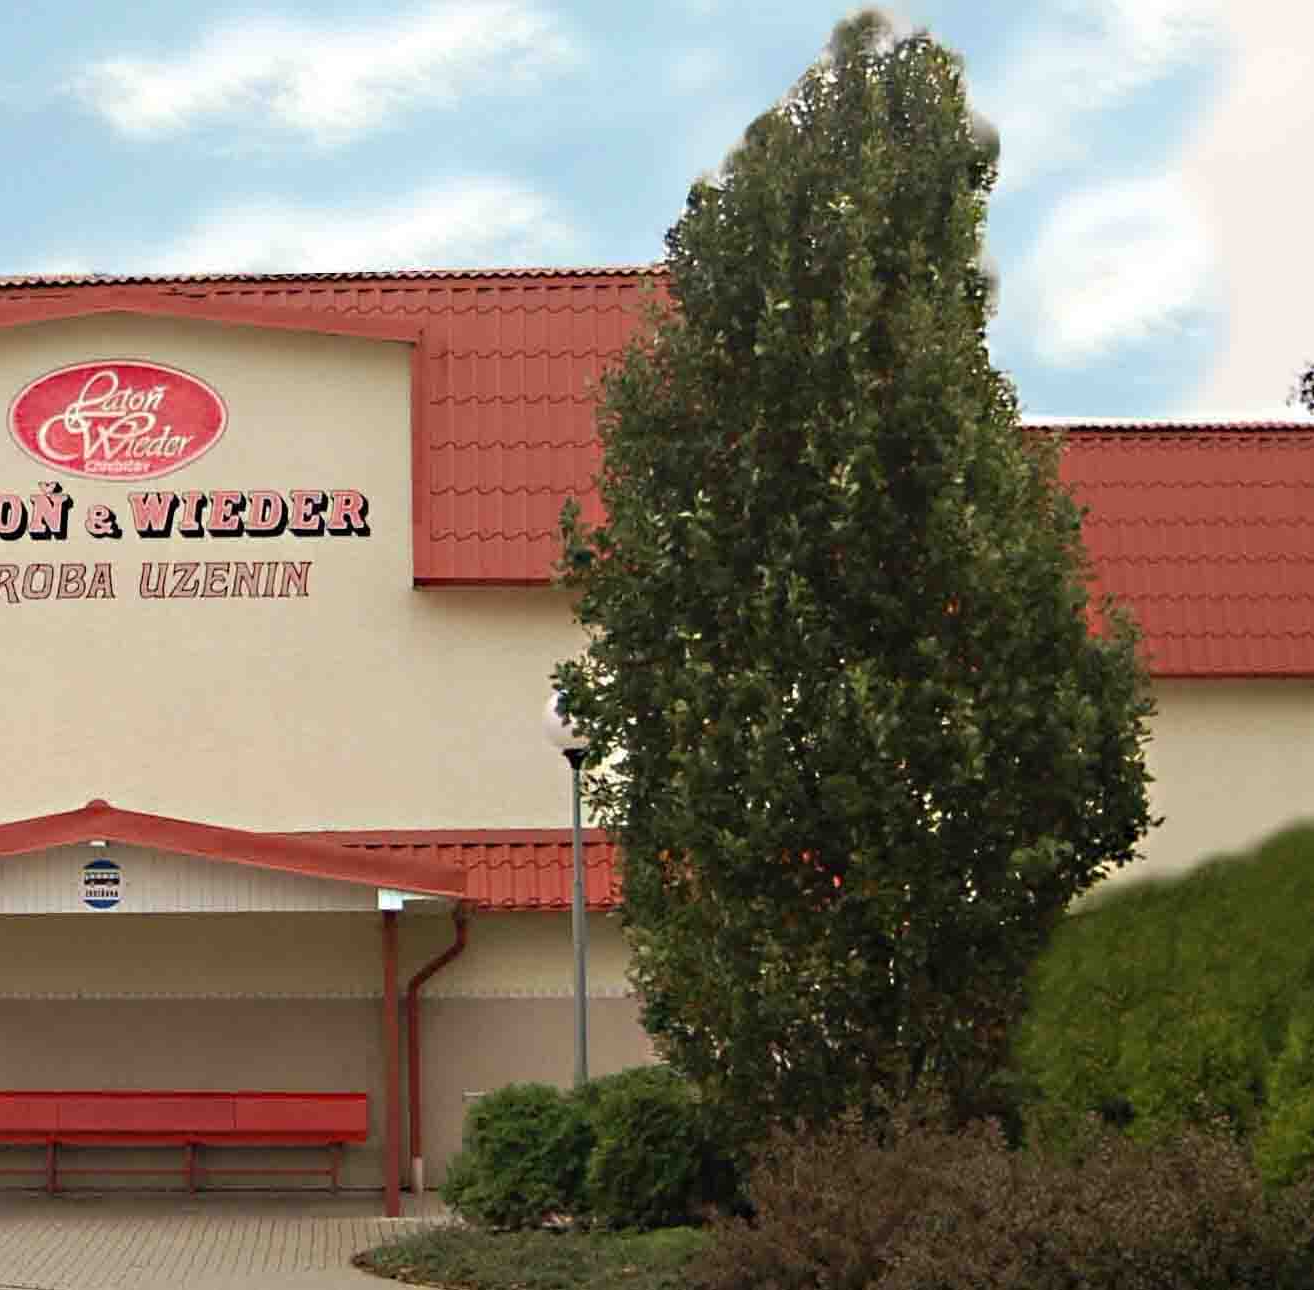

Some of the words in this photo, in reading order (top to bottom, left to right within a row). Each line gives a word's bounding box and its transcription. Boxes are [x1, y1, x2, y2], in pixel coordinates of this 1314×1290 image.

[64, 370, 167, 420] Latoň
[38, 412, 194, 461] Wieder
[85, 504, 123, 539] &
[127, 489, 371, 538] WIEDER
[139, 561, 313, 599] UZENIN
